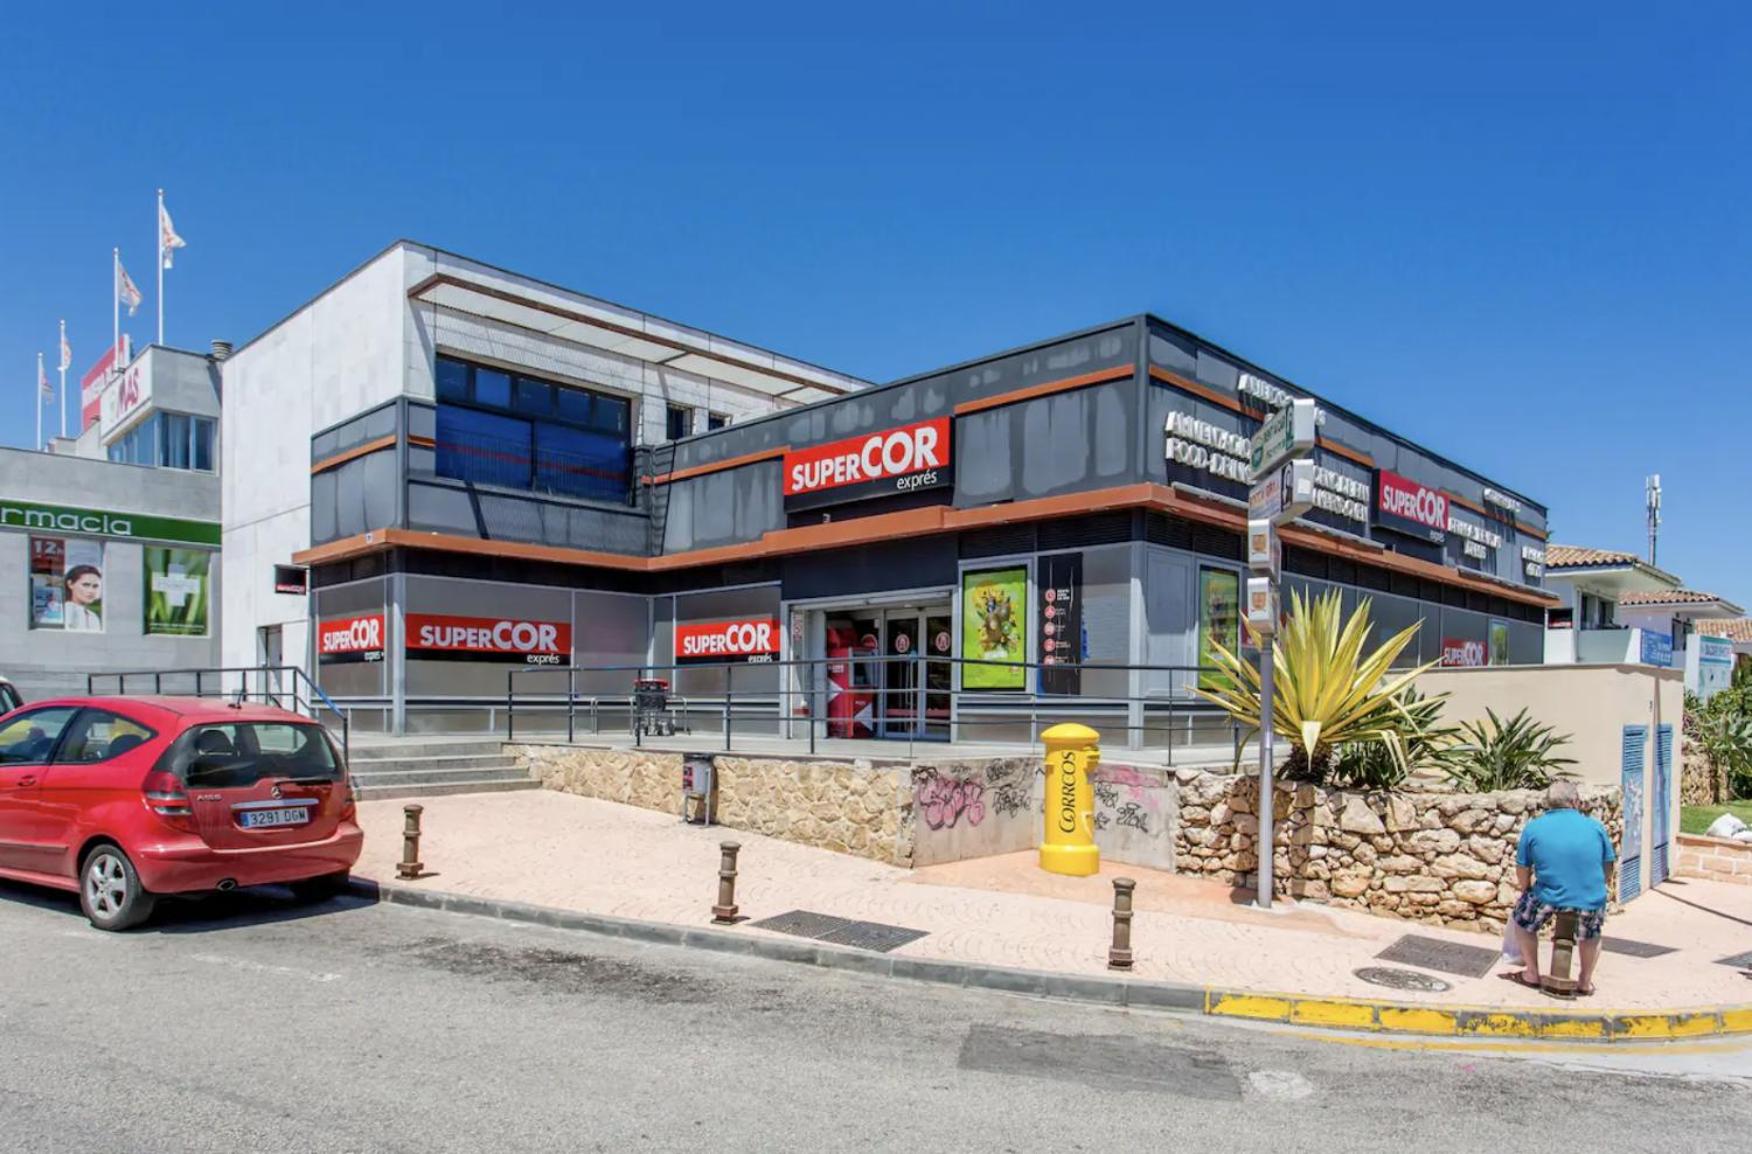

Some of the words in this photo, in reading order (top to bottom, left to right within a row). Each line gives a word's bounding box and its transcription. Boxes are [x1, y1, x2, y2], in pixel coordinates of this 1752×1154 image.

[792, 426, 939, 491] SUPERCOR
[896, 469, 938, 491] exprés
[1383, 484, 1446, 529] SUPERCOR
[323, 618, 380, 652] SUPERCOR
[420, 621, 560, 651] SUPERCOR
[683, 623, 772, 654] SUPERCOR
[526, 652, 561, 665] exprés
[250, 811, 279, 825] 3291
